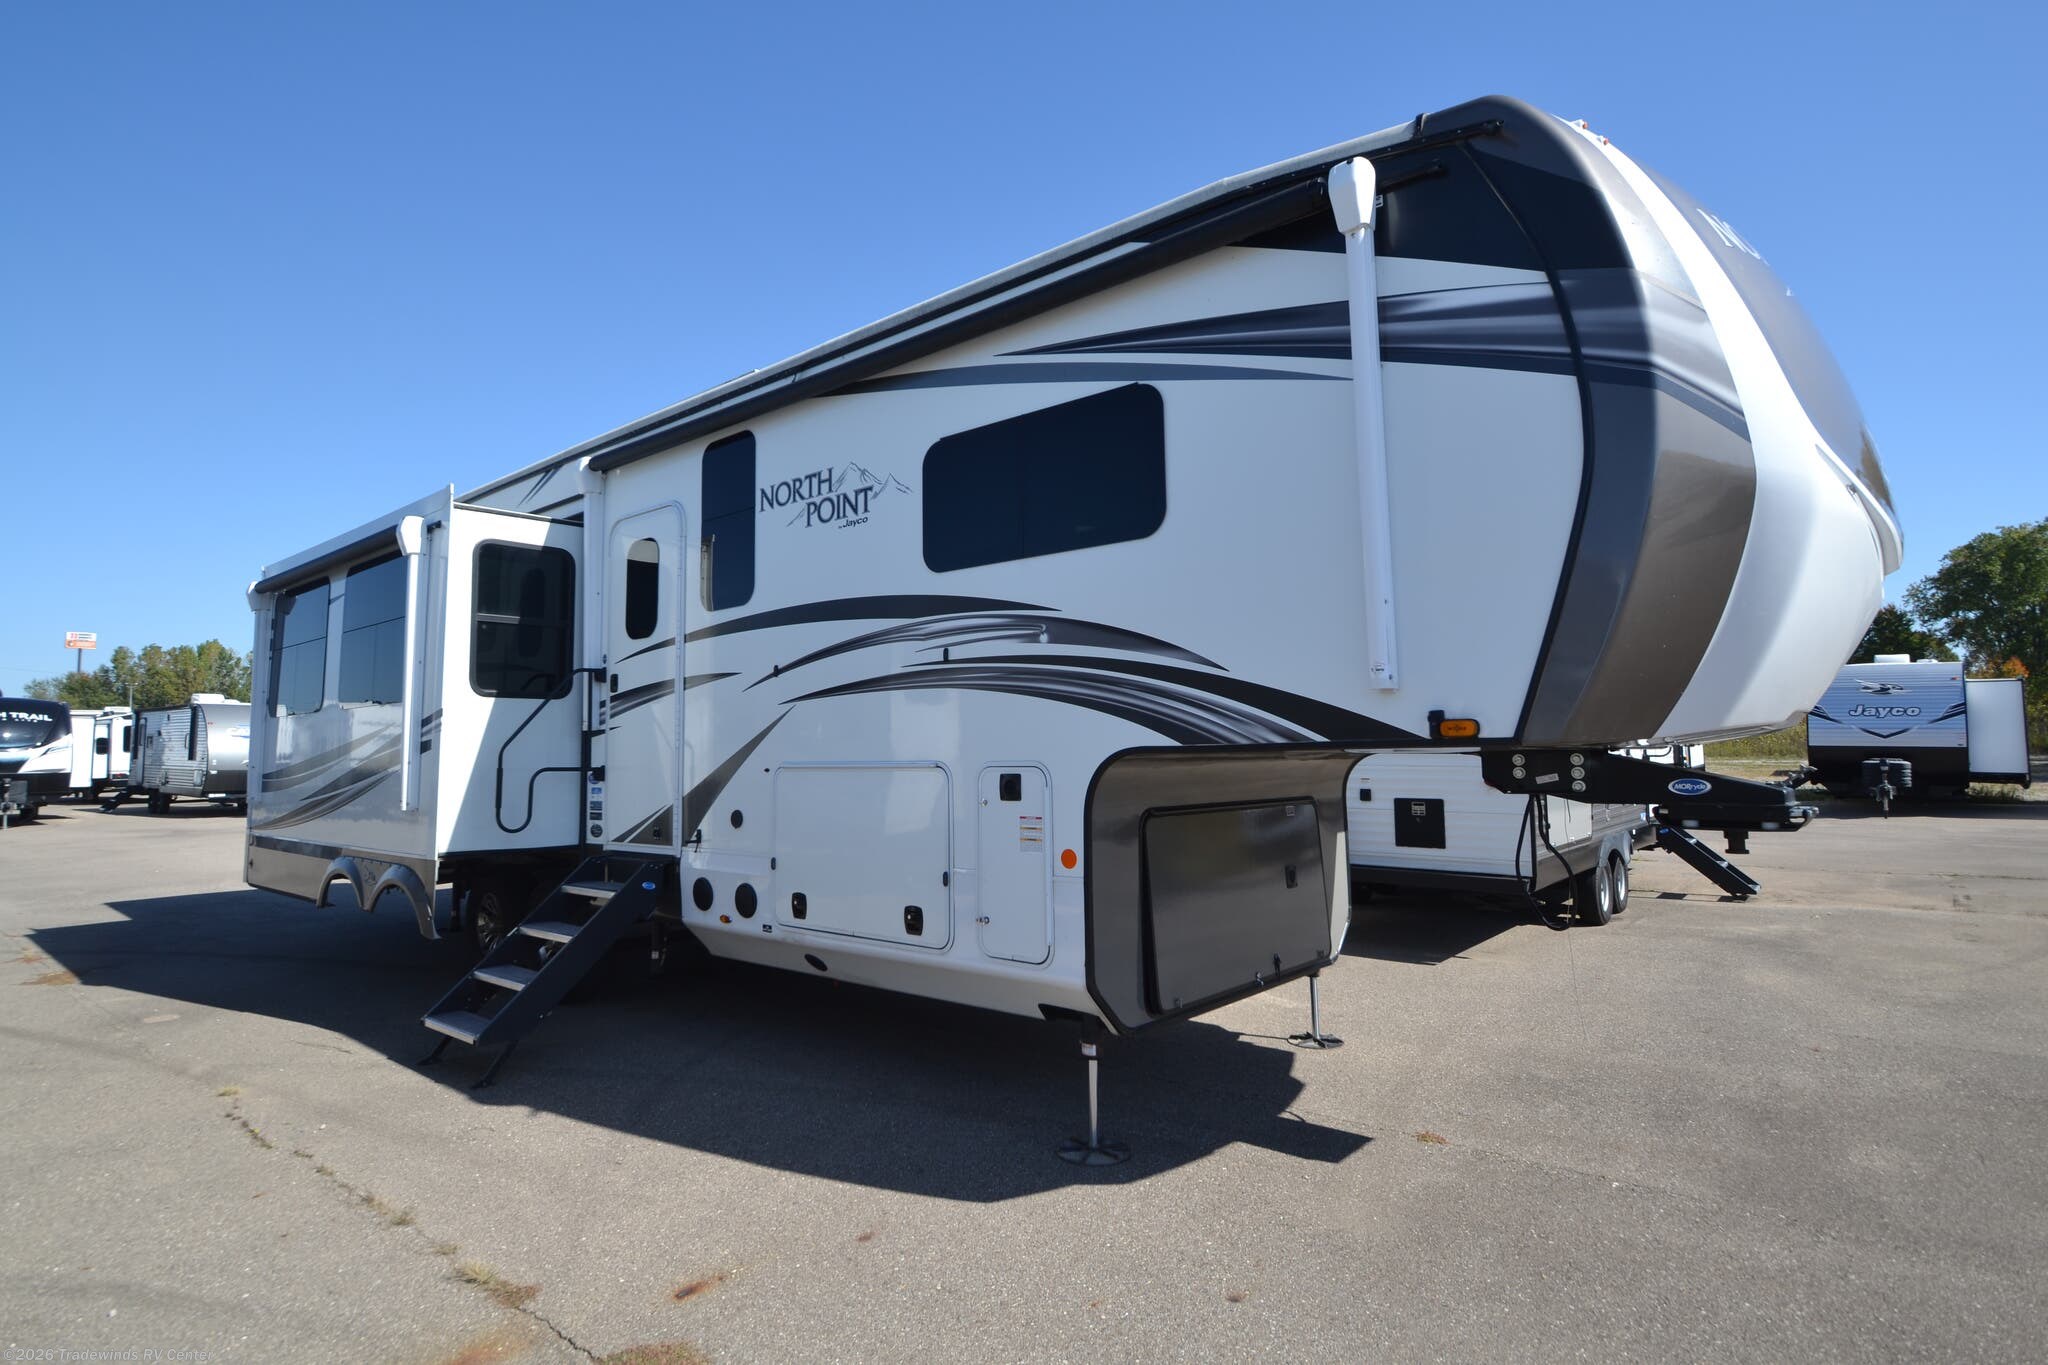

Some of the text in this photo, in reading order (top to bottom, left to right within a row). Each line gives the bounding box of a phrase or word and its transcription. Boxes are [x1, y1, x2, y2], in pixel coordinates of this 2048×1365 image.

[759, 467, 834, 512] NORTH
[805, 485, 874, 528] POINT
[8, 711, 53, 721] TRAIL
[1848, 704, 1921, 718] Jayco
